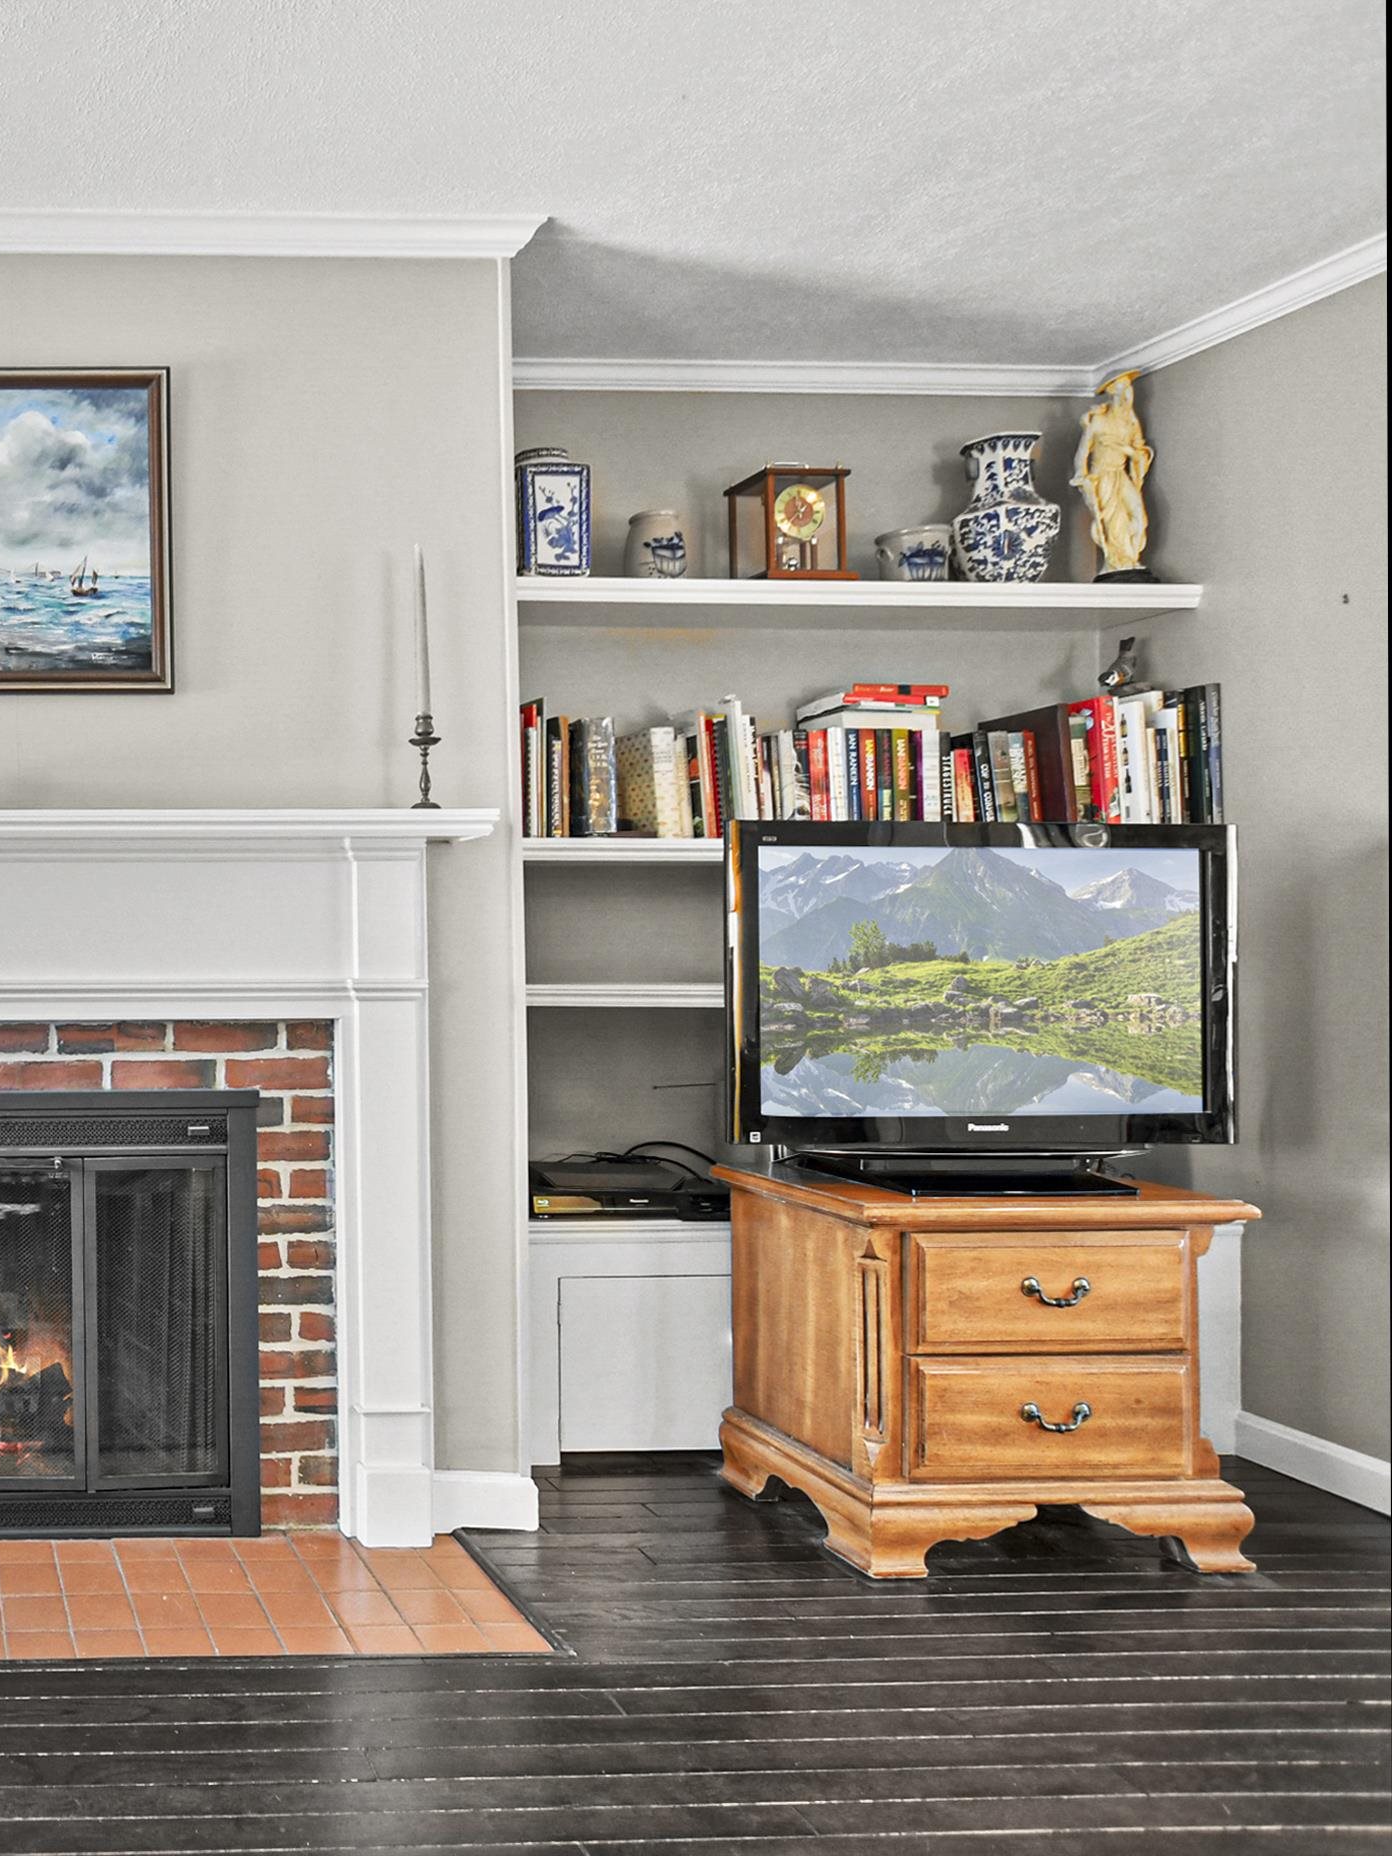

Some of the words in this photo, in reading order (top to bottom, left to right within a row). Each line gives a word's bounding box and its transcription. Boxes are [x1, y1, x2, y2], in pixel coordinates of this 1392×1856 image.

[849, 734, 858, 750] IAN
[849, 751, 859, 786] RANKIN
[980, 763, 990, 779] COP
[942, 755, 953, 816] STAGESTRUCK
[968, 1123, 1009, 1132] Panasonic
